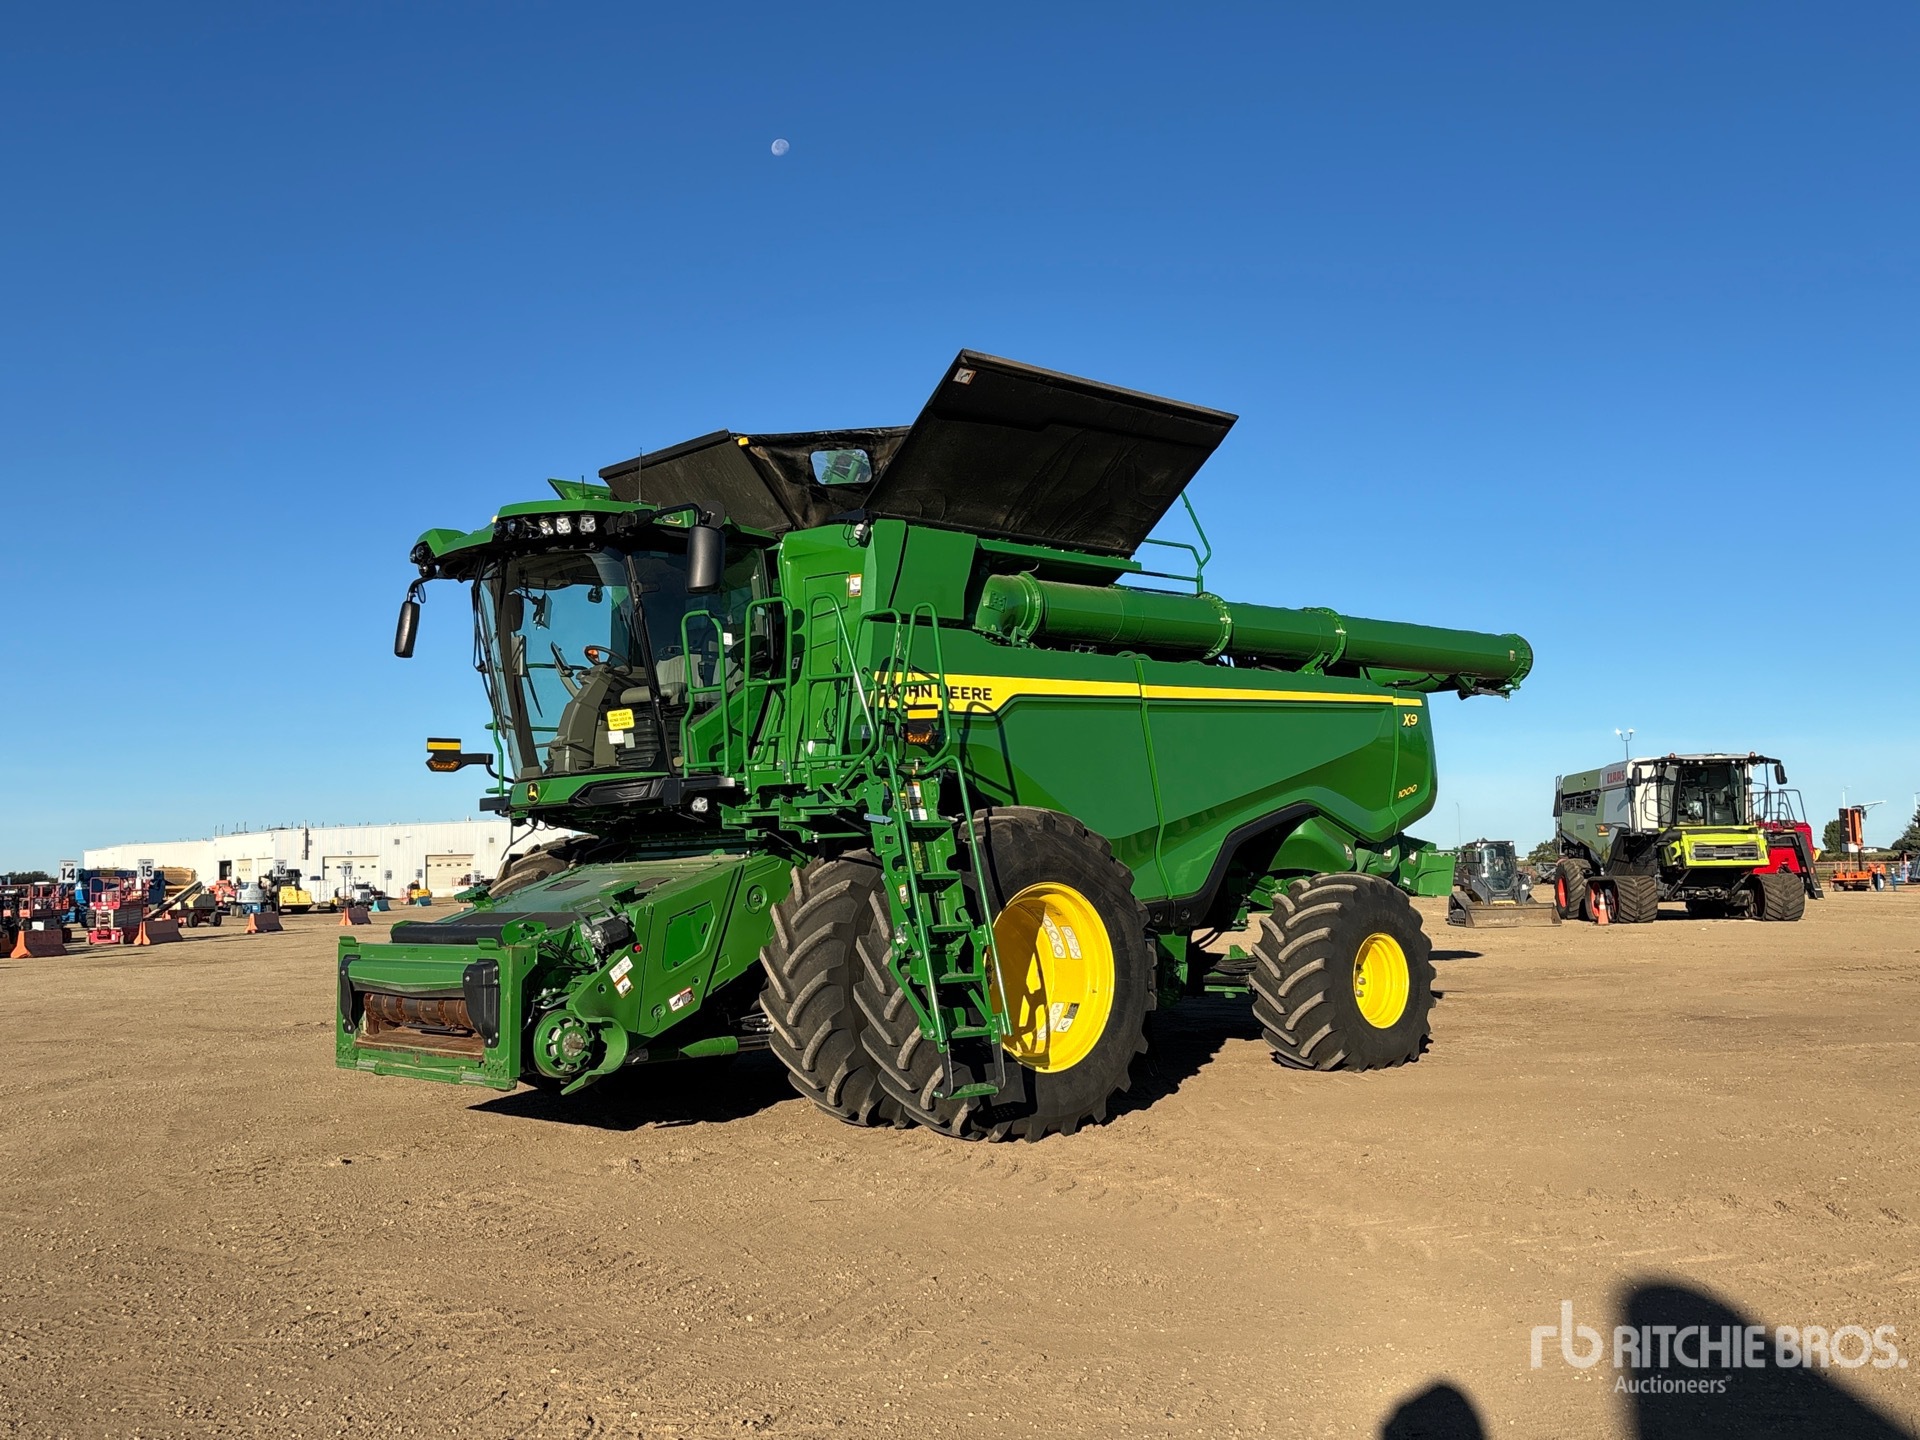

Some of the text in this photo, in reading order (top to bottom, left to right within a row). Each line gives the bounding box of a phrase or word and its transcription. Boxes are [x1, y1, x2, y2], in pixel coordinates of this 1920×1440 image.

[936, 683, 993, 701] DEERE
[1402, 713, 1418, 727] X9
[1607, 769, 1625, 784] CLAAS
[1397, 784, 1418, 799] 1000
[61, 868, 76, 881] 14
[140, 865, 153, 877] 15
[276, 865, 286, 875] 16
[343, 865, 353, 875] 17
